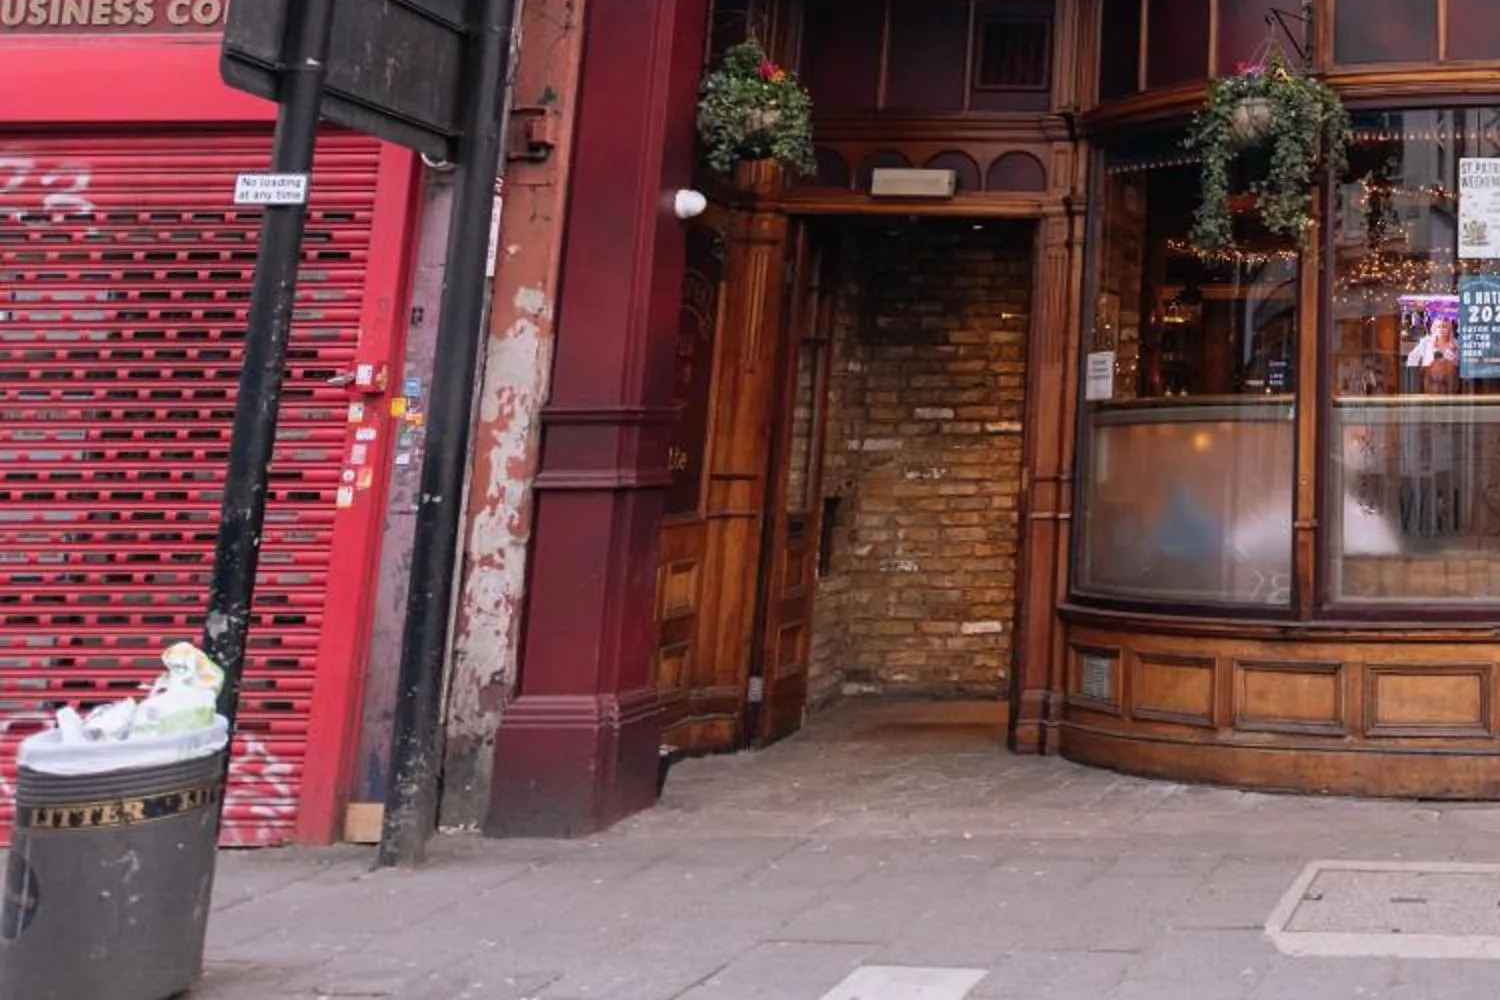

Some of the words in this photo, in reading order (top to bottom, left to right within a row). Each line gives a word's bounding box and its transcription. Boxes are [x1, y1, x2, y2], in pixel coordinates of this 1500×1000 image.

[242, 177, 257, 187] No
[260, 177, 301, 188] loading
[240, 190, 249, 199] at
[254, 191, 272, 201] any
[277, 190, 301, 200] time
